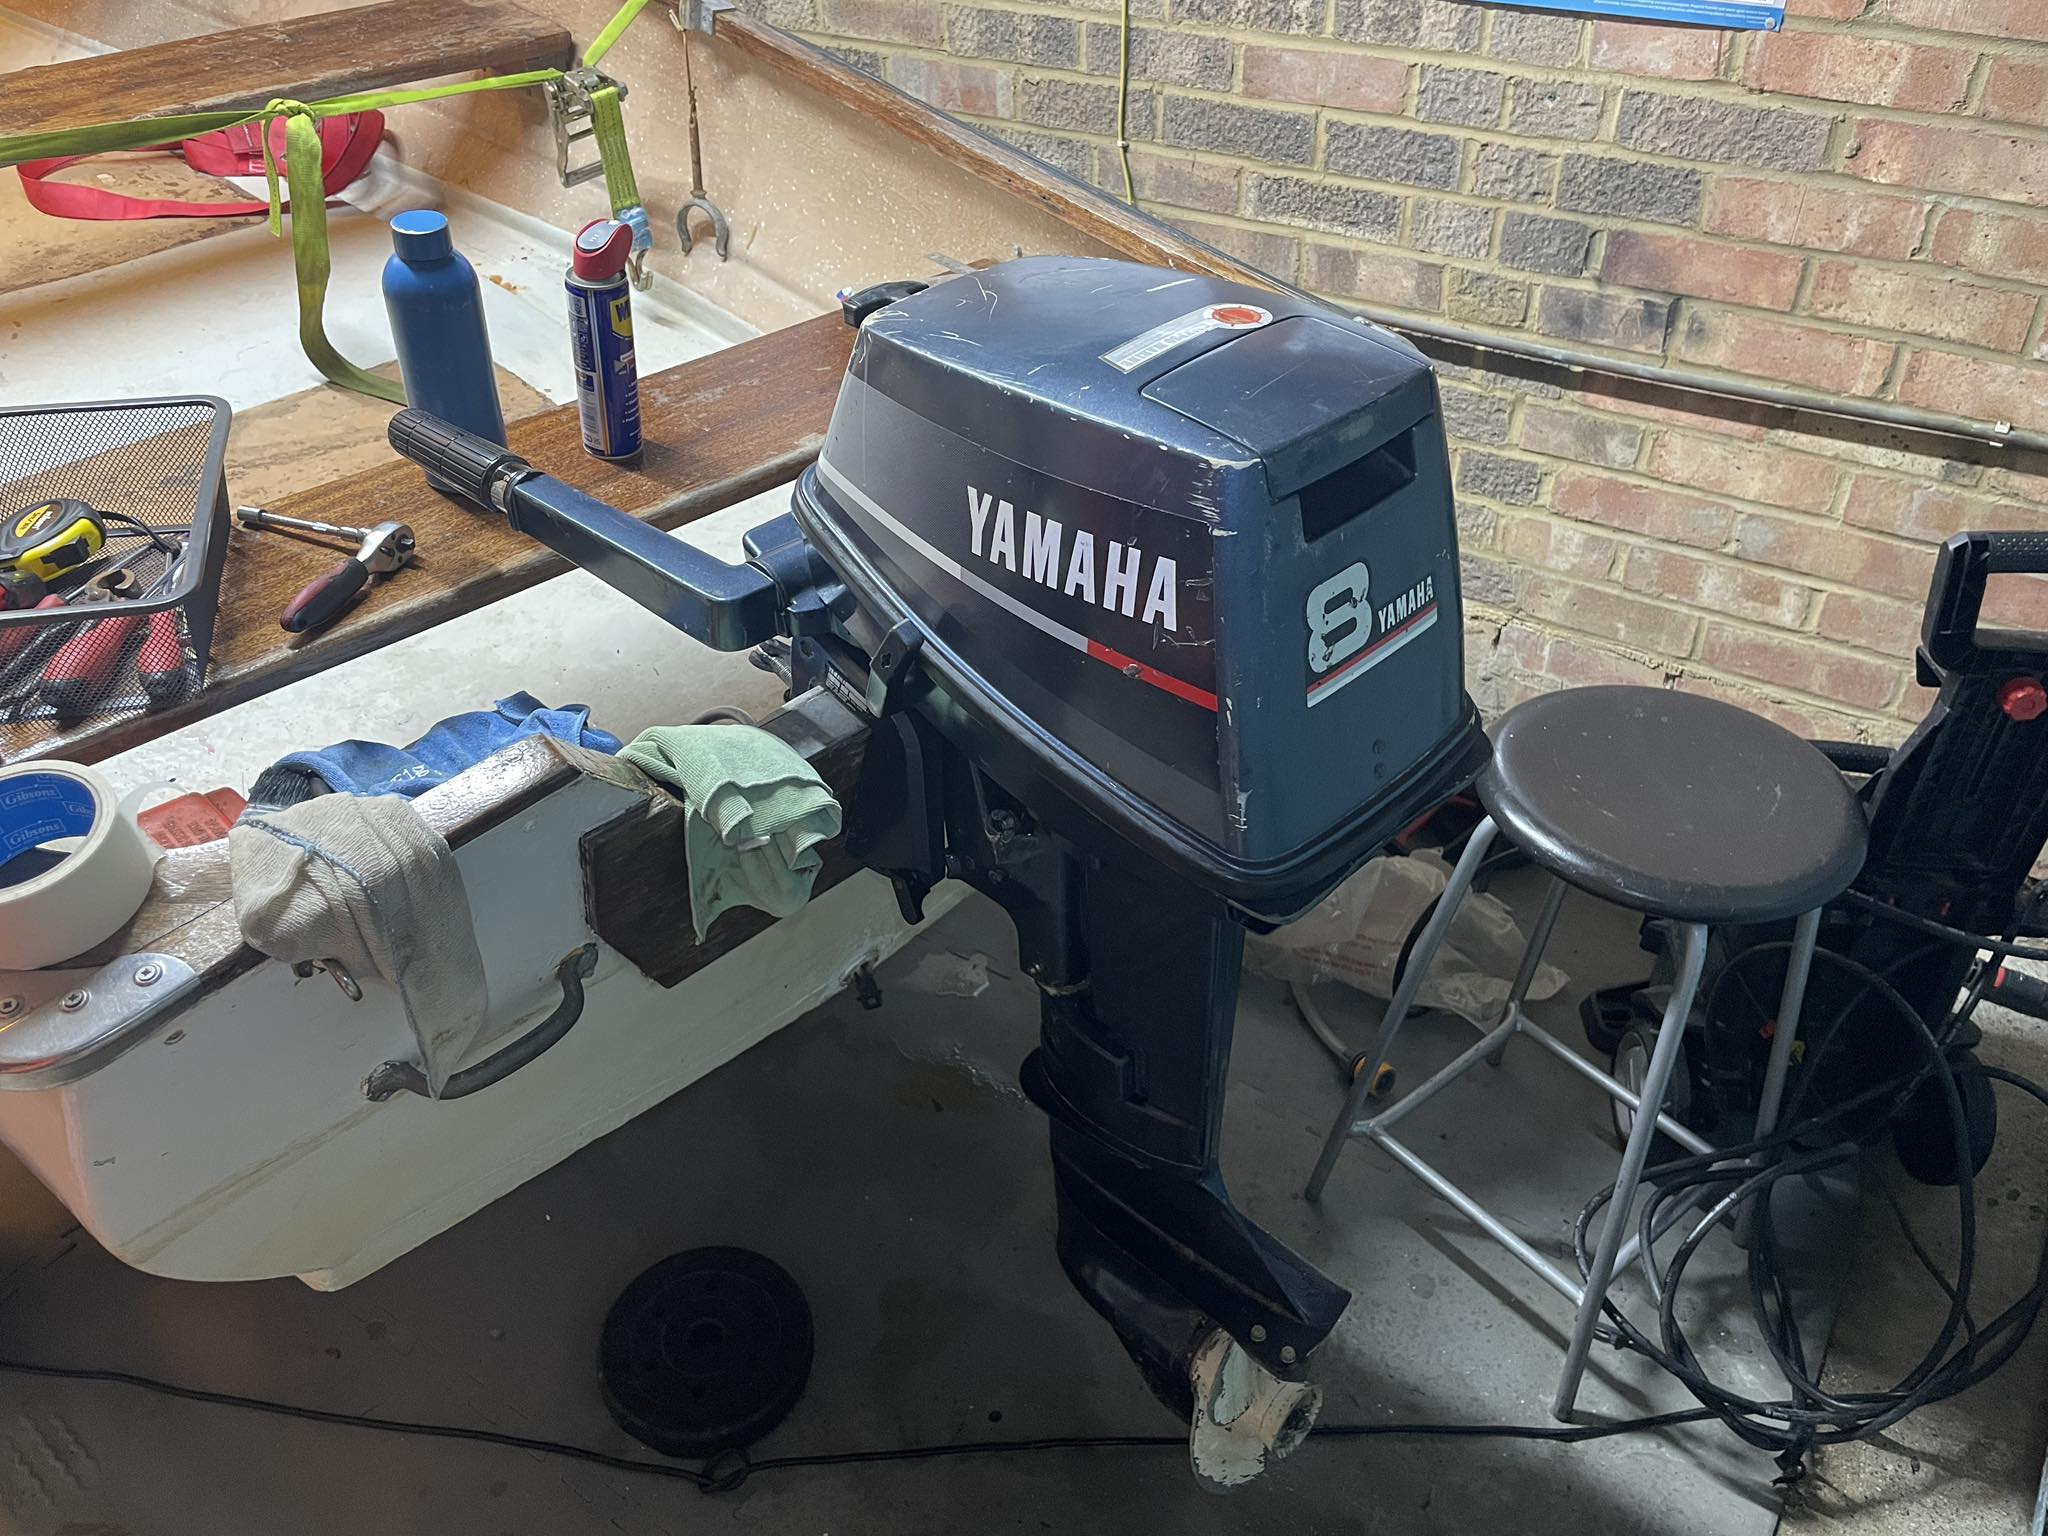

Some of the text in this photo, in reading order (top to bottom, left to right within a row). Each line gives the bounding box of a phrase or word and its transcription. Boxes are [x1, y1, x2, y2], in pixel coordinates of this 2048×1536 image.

[967, 485, 1178, 632] YAMAHA
[1306, 561, 1373, 674] 8
[1377, 575, 1434, 634] YAMAHA
[5, 788, 58, 806] Gibsons
[10, 822, 61, 846] Gibsons
